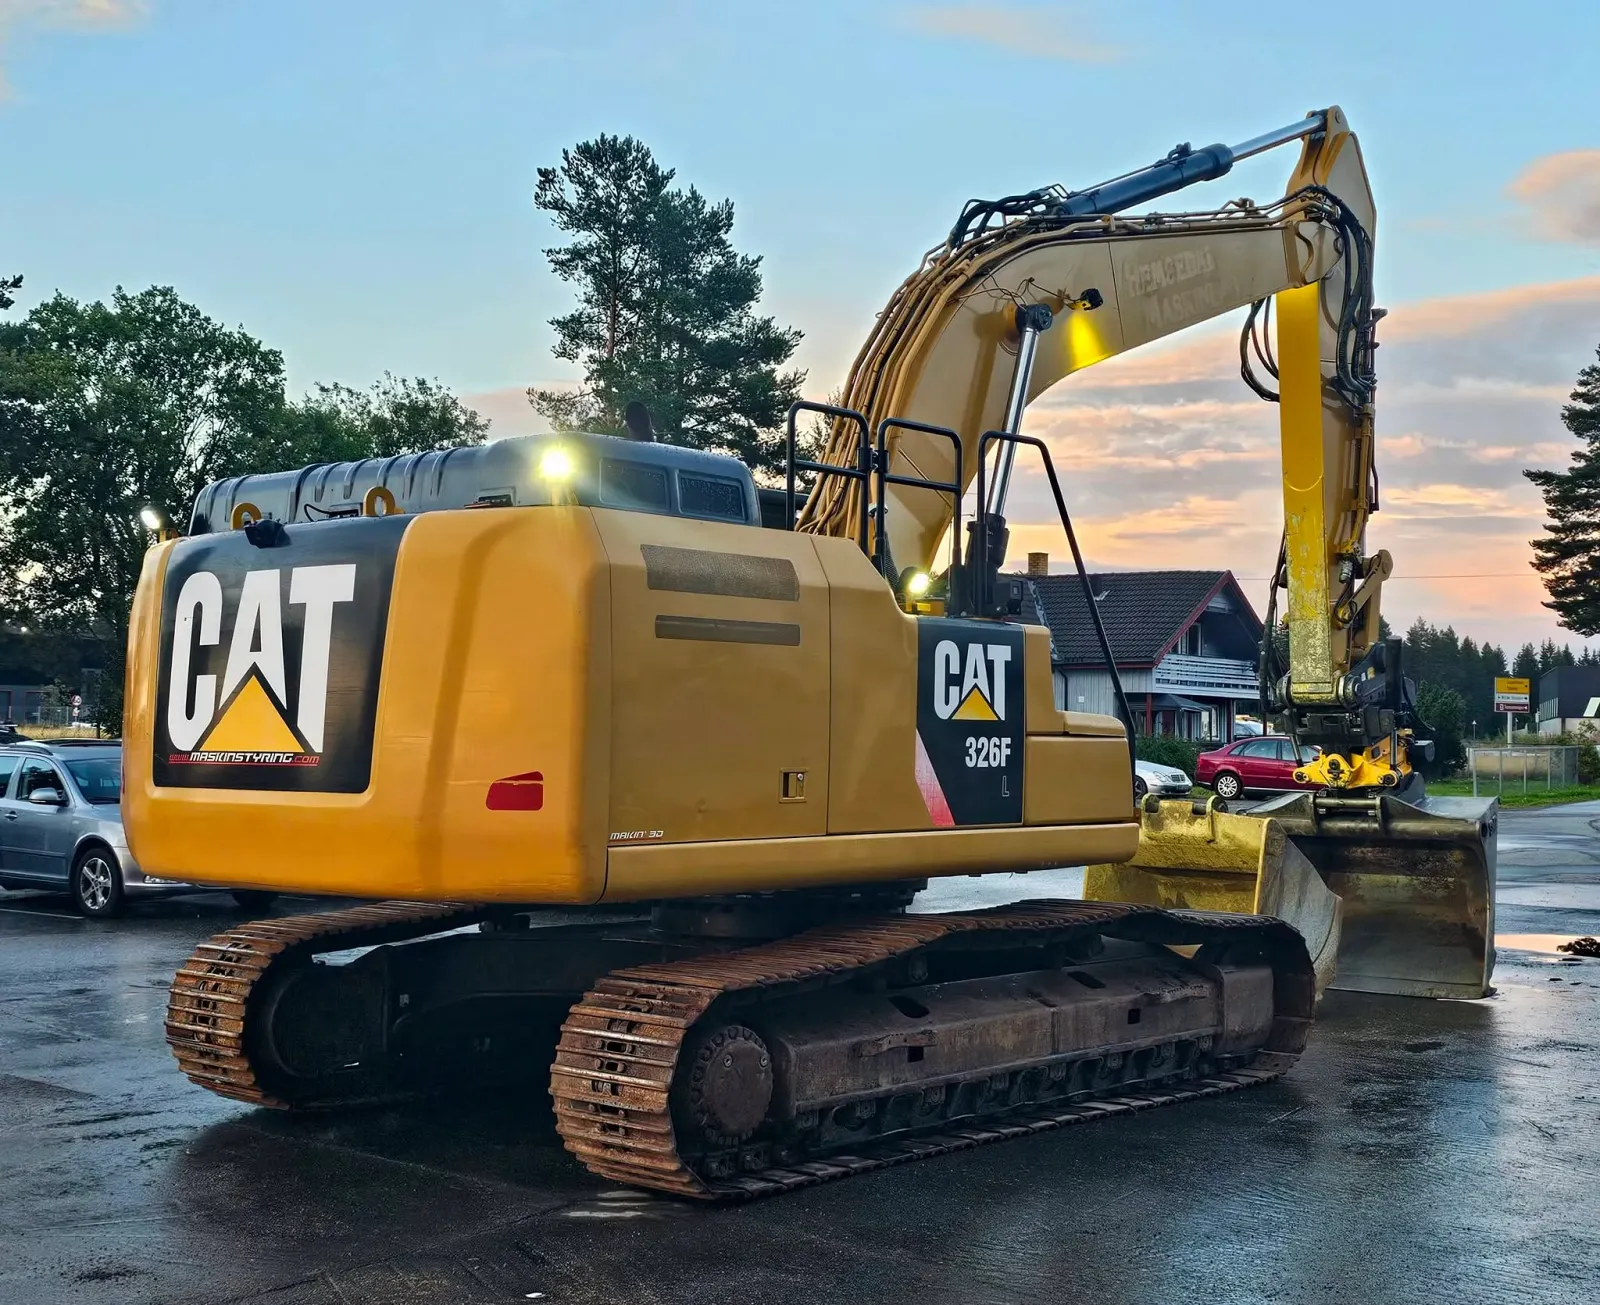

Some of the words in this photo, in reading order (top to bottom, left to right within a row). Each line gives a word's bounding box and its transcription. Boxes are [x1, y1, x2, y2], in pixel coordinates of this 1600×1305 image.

[168, 564, 356, 752] CAT
[934, 640, 1011, 720] CAT
[965, 737, 1011, 767] 326F
[1002, 776, 1010, 796] L
[648, 830, 664, 838] 3D
